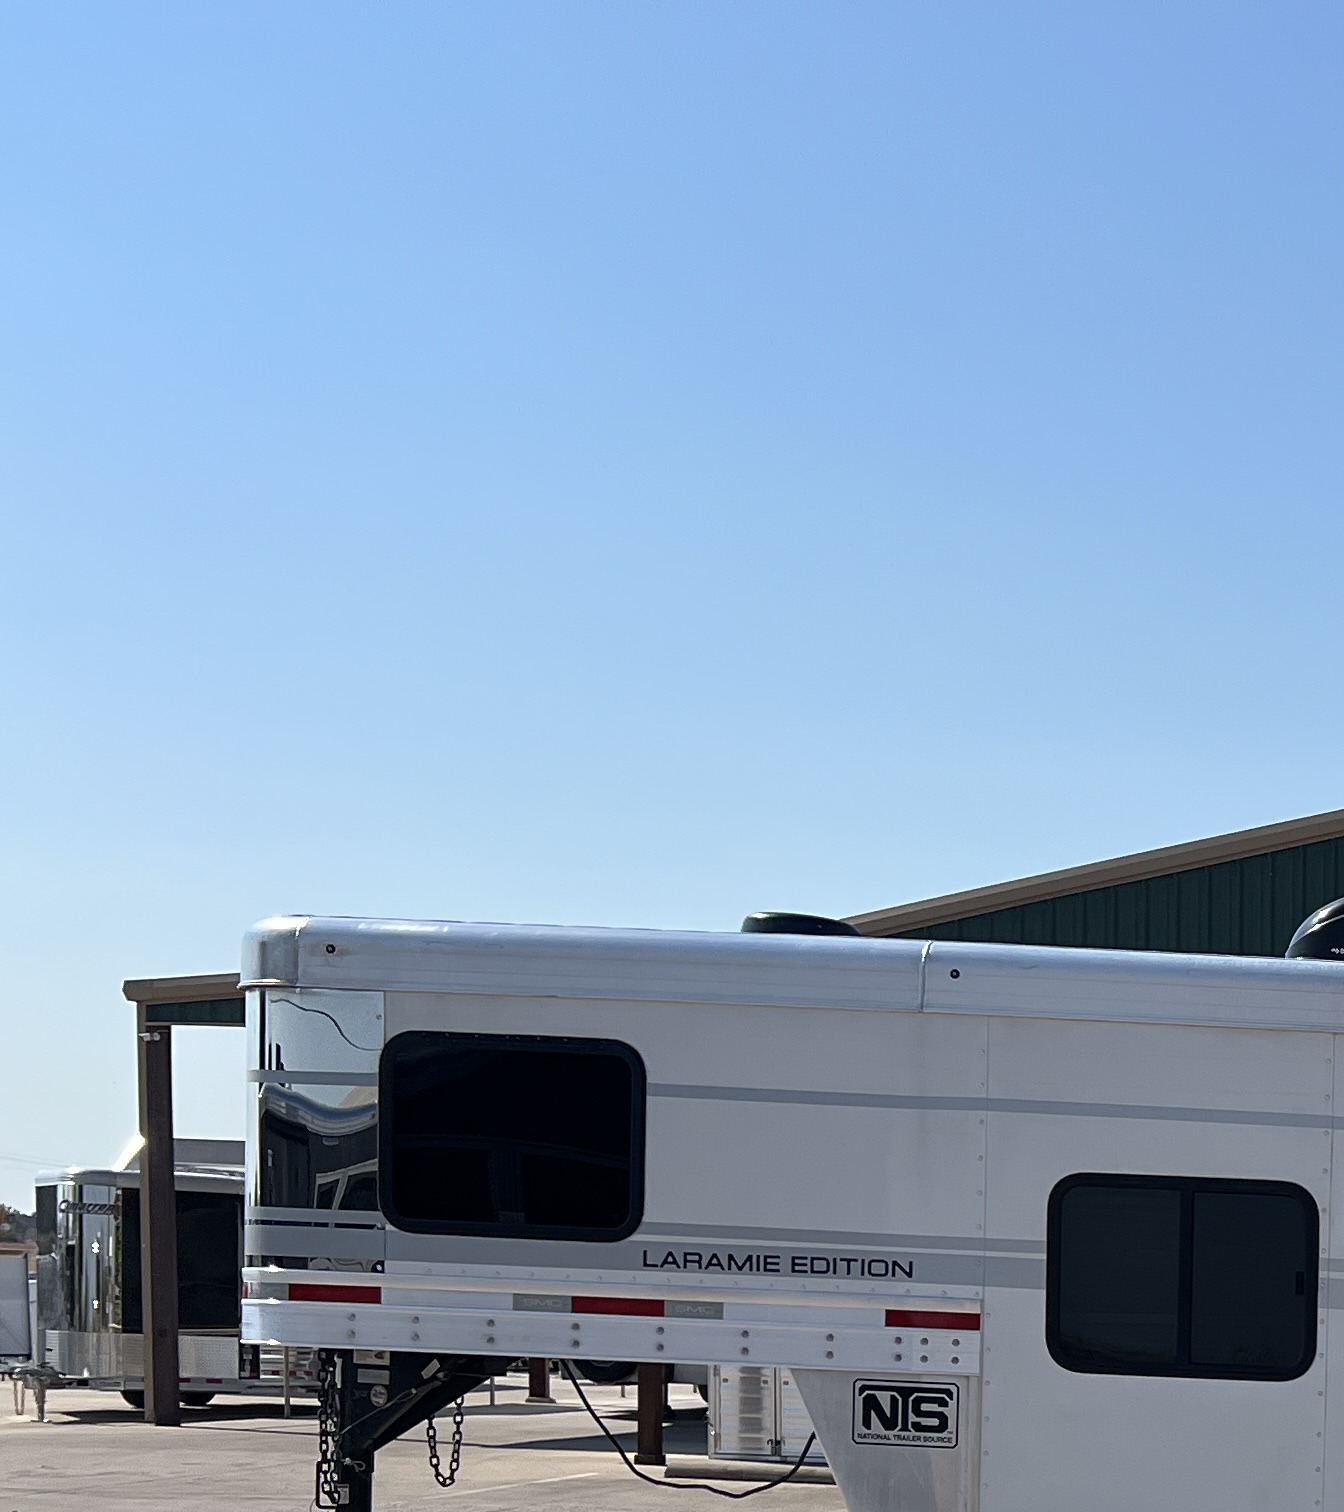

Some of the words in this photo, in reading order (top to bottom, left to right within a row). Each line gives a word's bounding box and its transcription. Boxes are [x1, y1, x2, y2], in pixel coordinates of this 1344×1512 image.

[642, 1249, 781, 1273] LARAMIE
[790, 1255, 914, 1279] EDITION
[858, 1383, 954, 1434] NTS
[856, 1432, 892, 1442] NATIONAL
[892, 1434, 922, 1443] TRAILER
[922, 1435, 953, 1444] SOURCE
